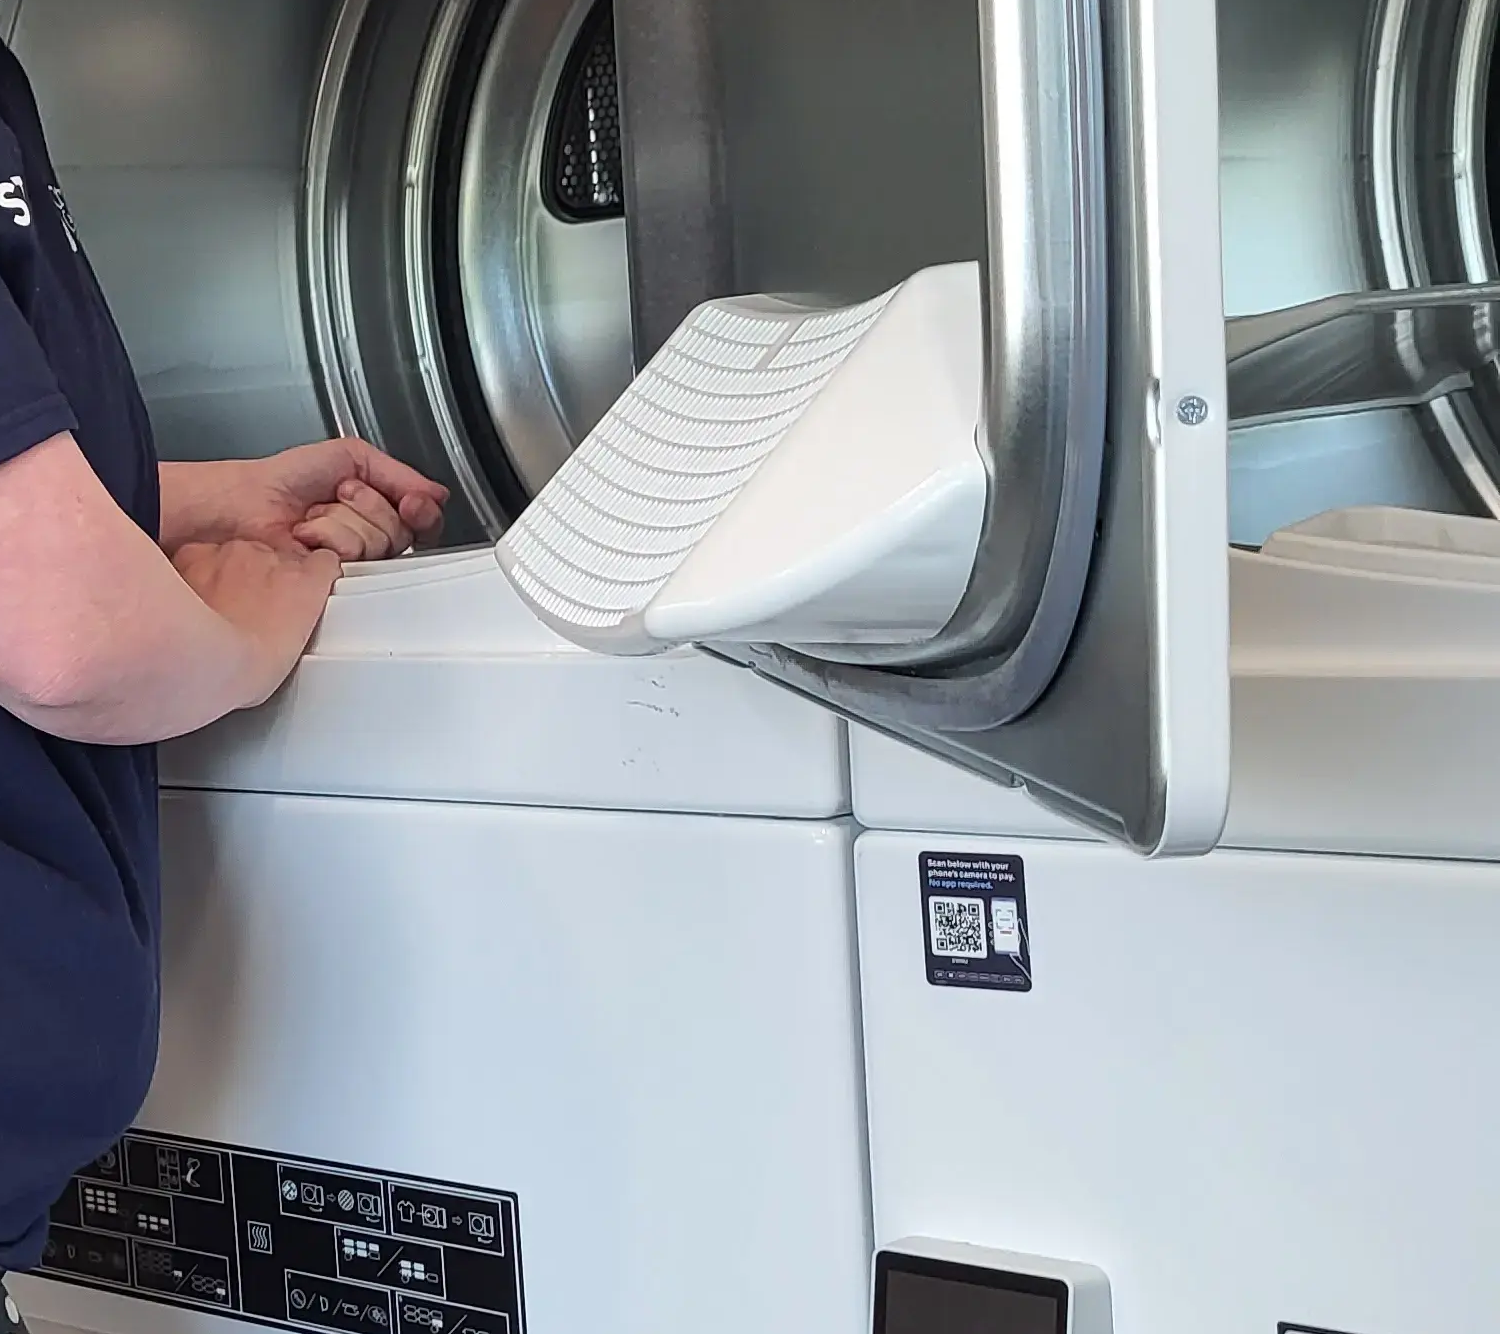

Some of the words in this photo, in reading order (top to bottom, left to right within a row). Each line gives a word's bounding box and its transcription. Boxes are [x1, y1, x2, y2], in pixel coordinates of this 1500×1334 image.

[947, 859, 972, 869] below
[972, 862, 990, 870] with
[991, 863, 1009, 872] your
[989, 872, 998, 880] to
